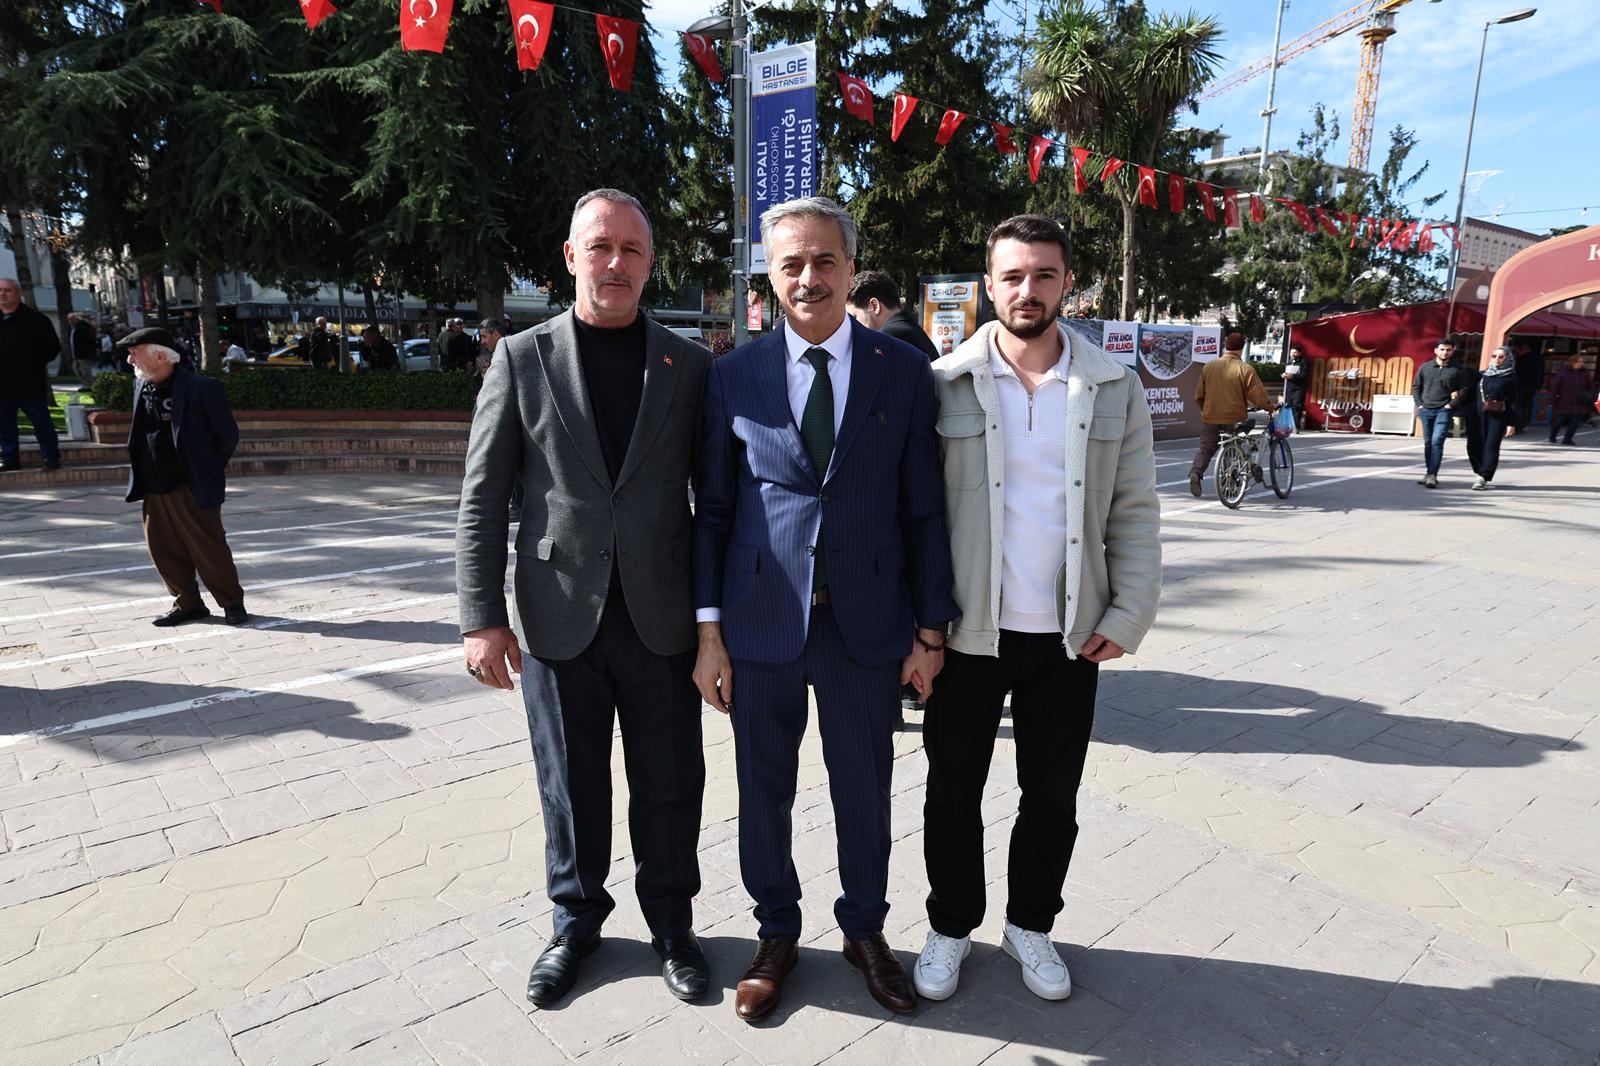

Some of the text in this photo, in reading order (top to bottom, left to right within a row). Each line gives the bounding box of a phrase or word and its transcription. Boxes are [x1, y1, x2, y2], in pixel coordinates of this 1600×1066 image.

[757, 141, 768, 201] KAPALI
[769, 126, 780, 202] NDOSKOPİK)
[781, 108, 796, 201] YUN FITIĞI
[798, 118, 812, 200] ERRAHİSİ
[1144, 387, 1180, 400] KENTSEL
[1148, 401, 1184, 415] ÖNÜŞÜM
